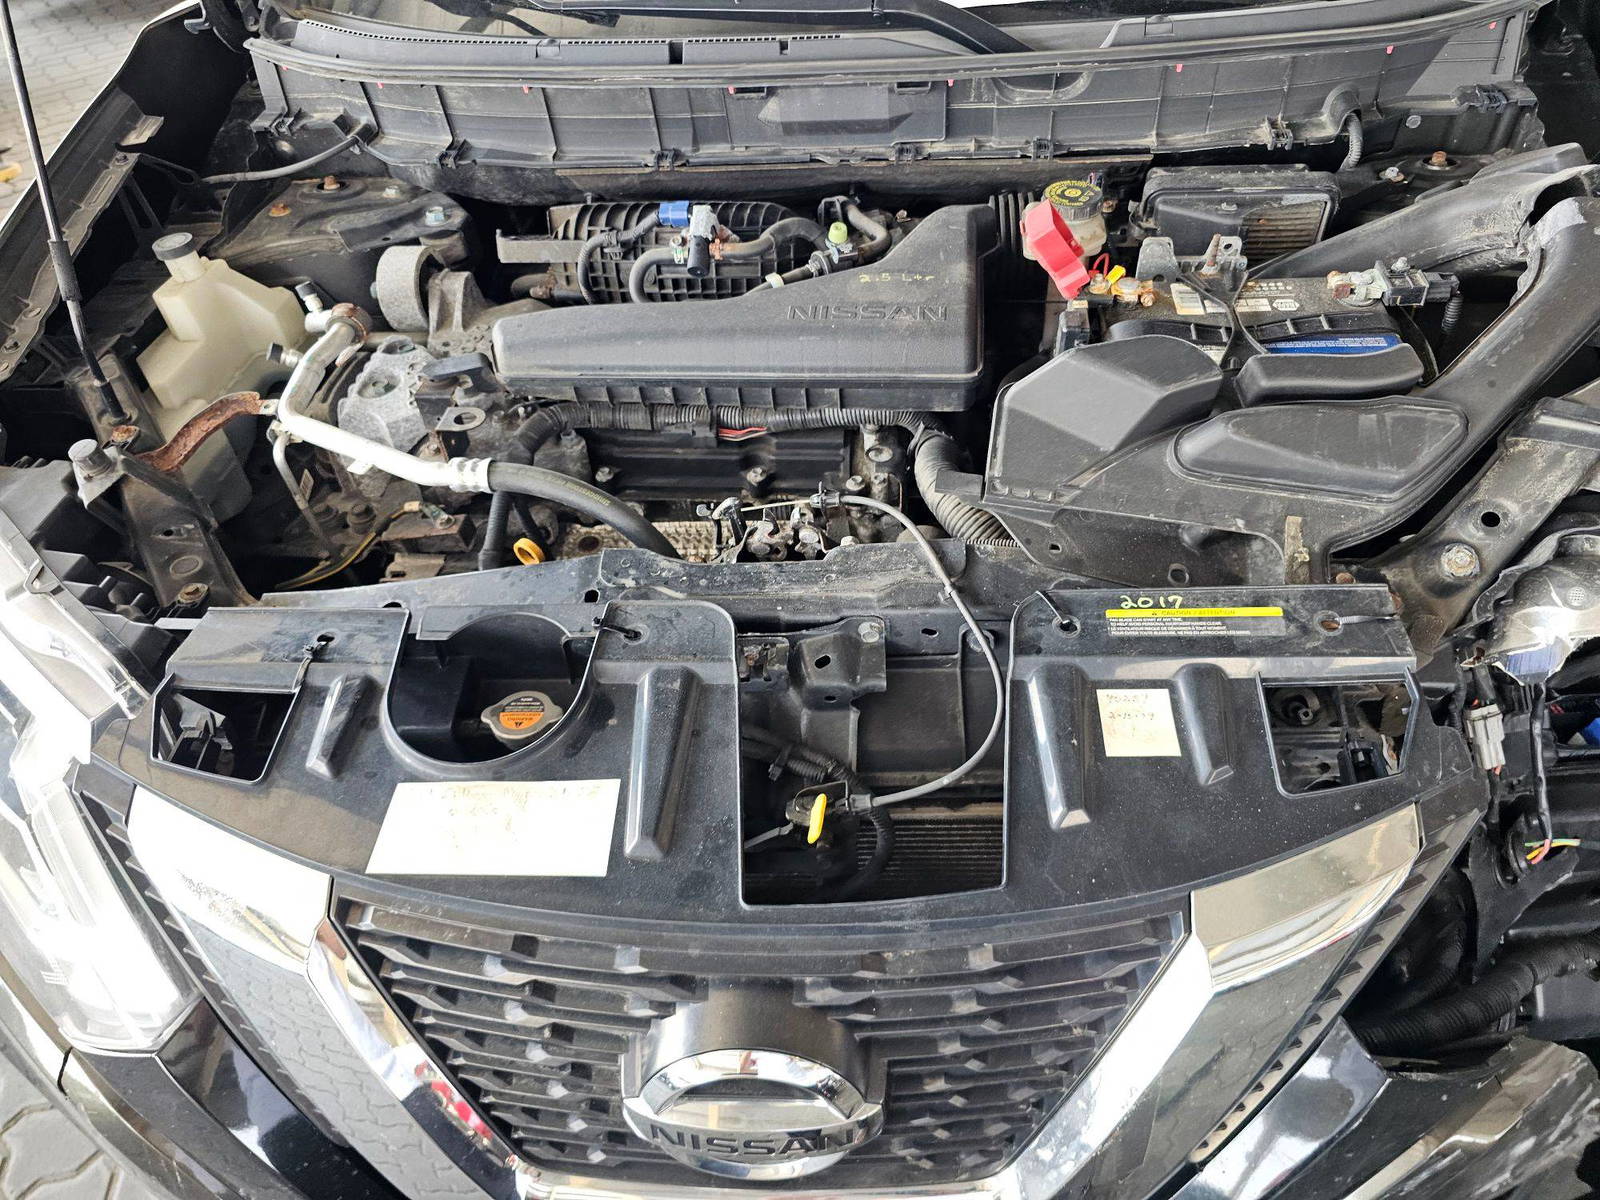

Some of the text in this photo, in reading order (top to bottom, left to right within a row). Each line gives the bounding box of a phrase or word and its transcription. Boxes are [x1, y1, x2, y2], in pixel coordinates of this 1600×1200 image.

[859, 273, 891, 283] 2.5
[786, 304, 948, 321] NISSAN
[1120, 595, 1183, 609] 2017
[651, 1124, 855, 1155] NISSAN
